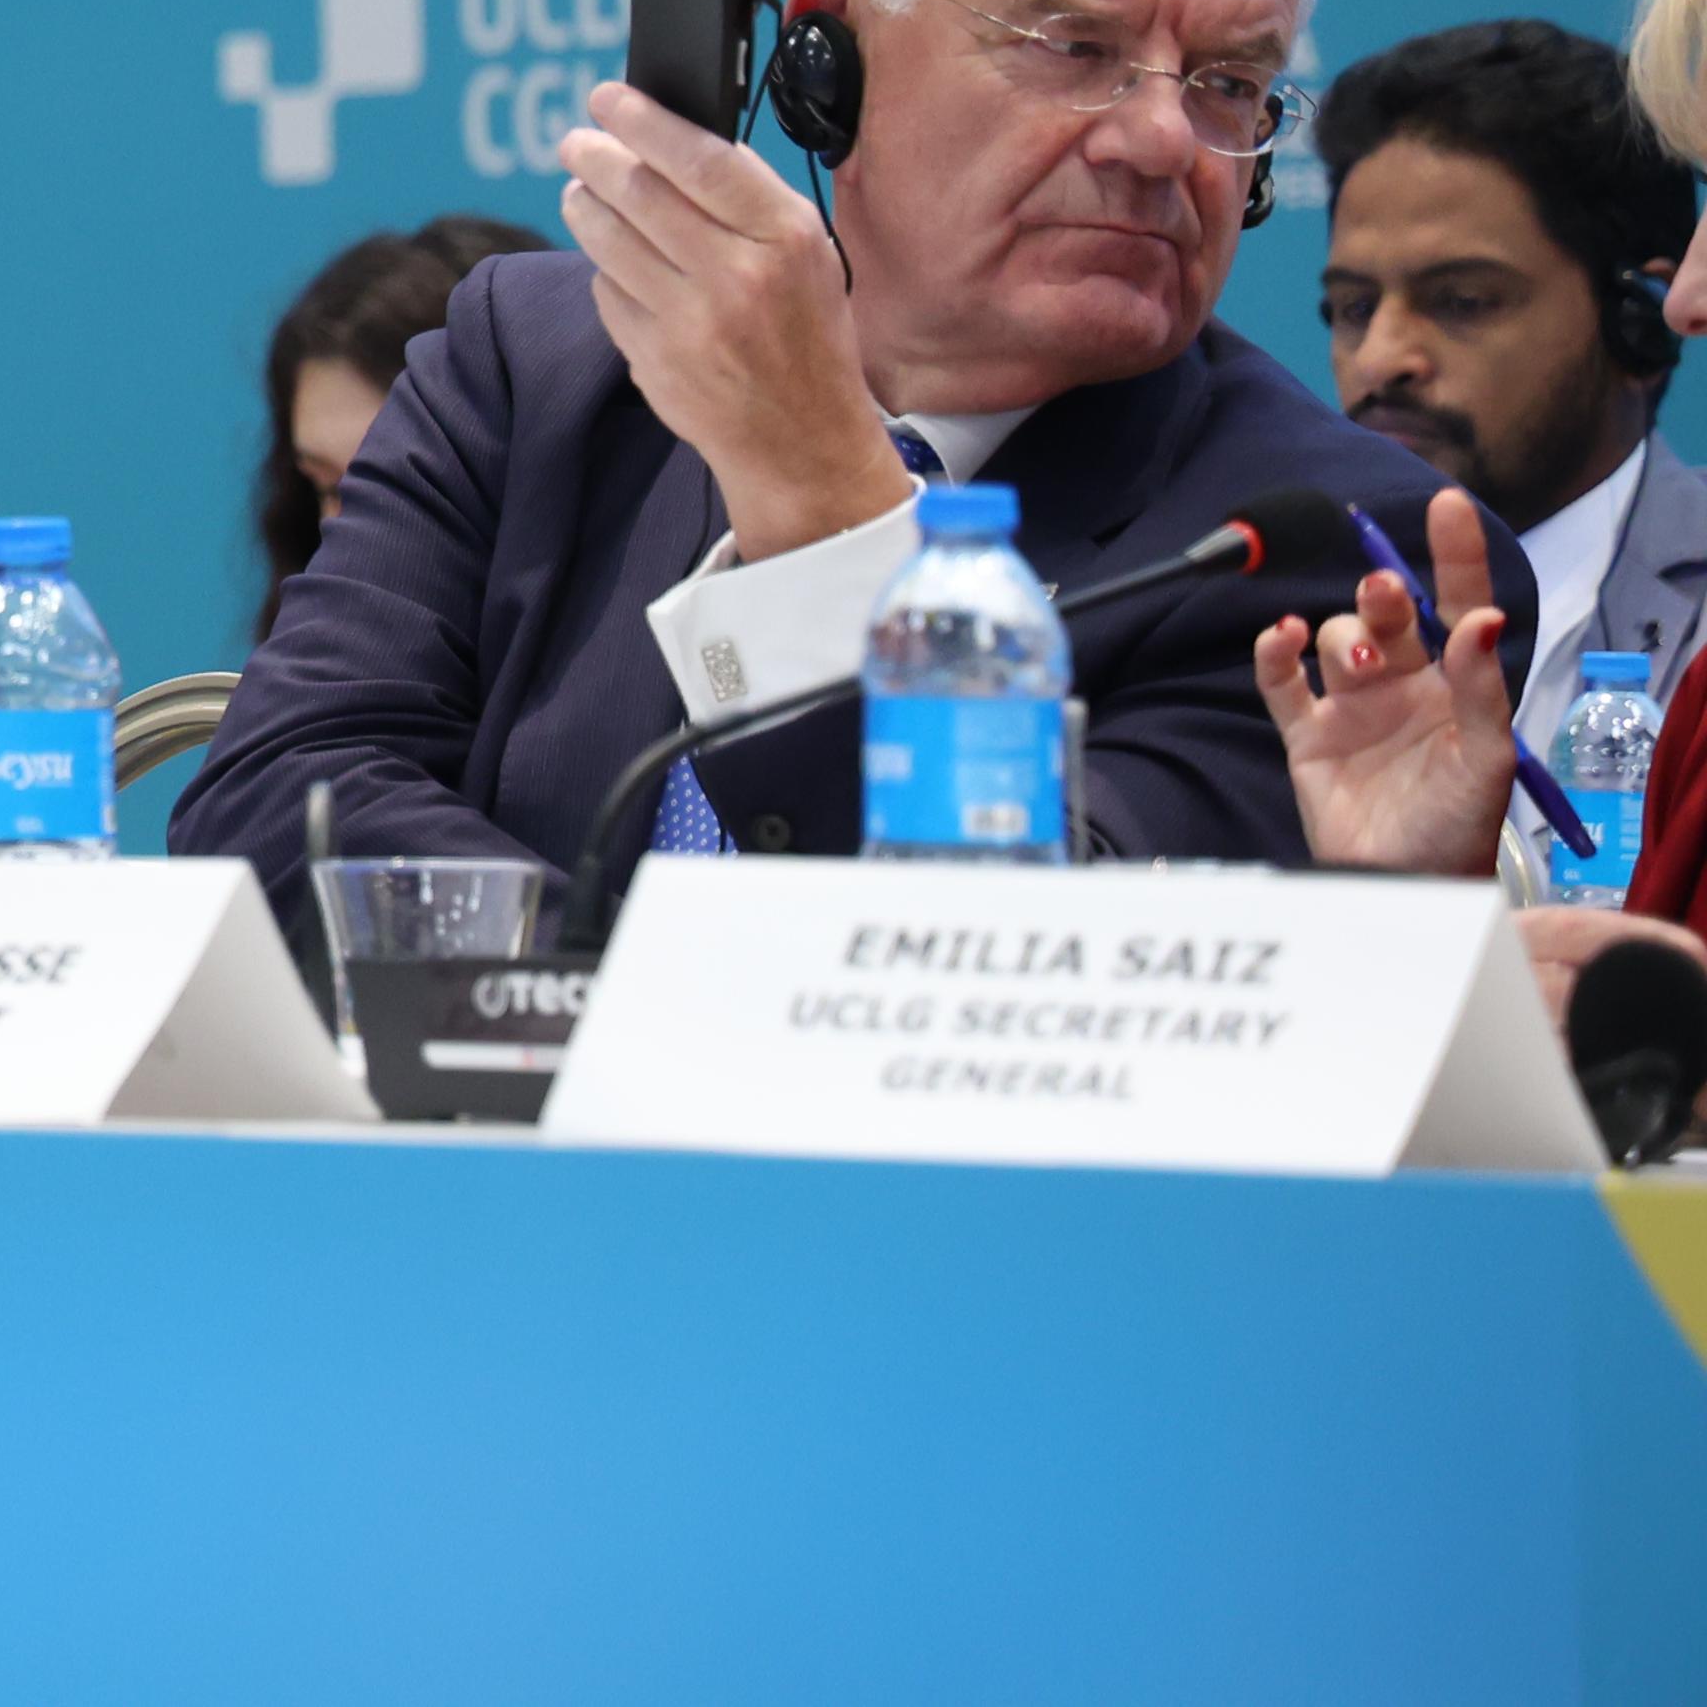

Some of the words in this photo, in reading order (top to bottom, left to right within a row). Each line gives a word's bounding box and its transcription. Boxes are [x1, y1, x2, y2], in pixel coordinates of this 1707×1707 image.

[461, 61, 627, 179] CG
[843, 925, 1087, 976] EMILIA
[1113, 936, 1283, 985] SAIZ
[787, 991, 935, 1036] UCLG
[951, 999, 1289, 1048] SECRETARY
[881, 1057, 1134, 1099] GENERAL
